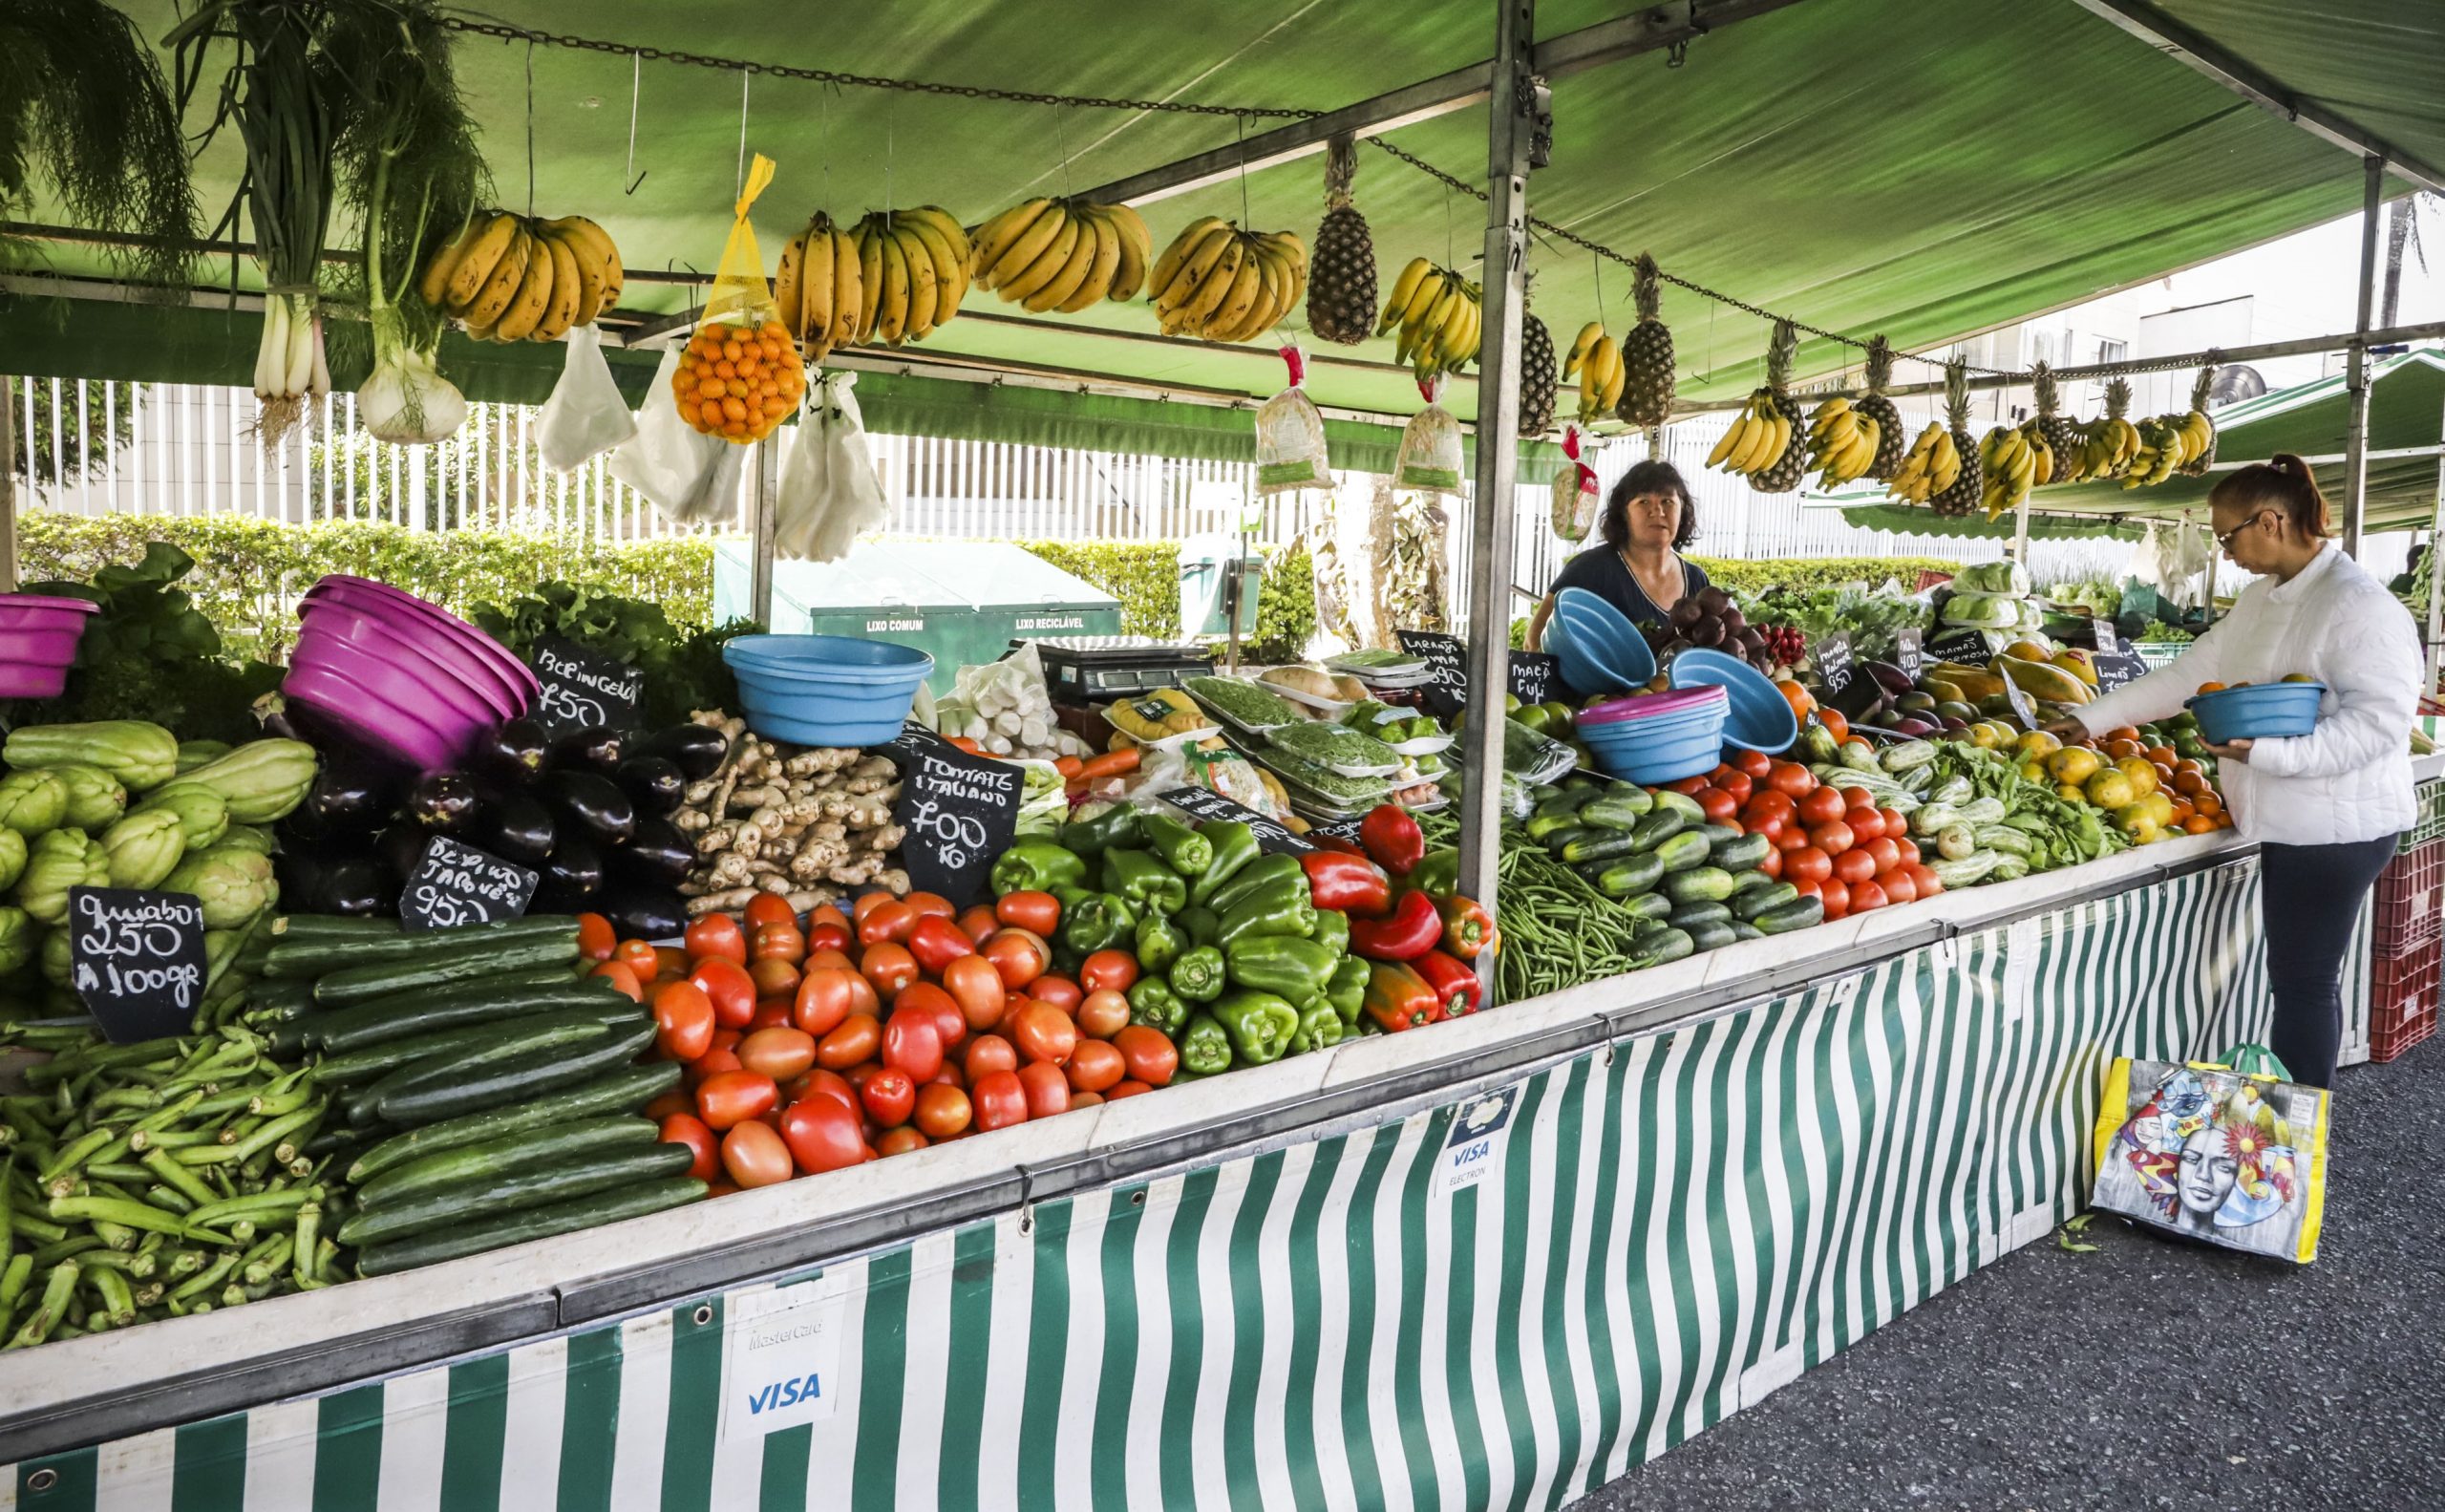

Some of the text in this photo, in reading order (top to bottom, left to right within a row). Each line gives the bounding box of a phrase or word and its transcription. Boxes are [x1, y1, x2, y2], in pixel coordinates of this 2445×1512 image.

[866, 620, 924, 632] LIXO COMUM
[1015, 615, 1084, 629] LIXO RECICLÁVEL
[924, 756, 1013, 791] TOMATE
[939, 842, 966, 870] KG
[81, 922, 181, 956] 250
[1455, 1140, 1490, 1167] VISA
[1449, 1166, 1487, 1186] ELECTRON
[749, 1374, 820, 1415] VISA
